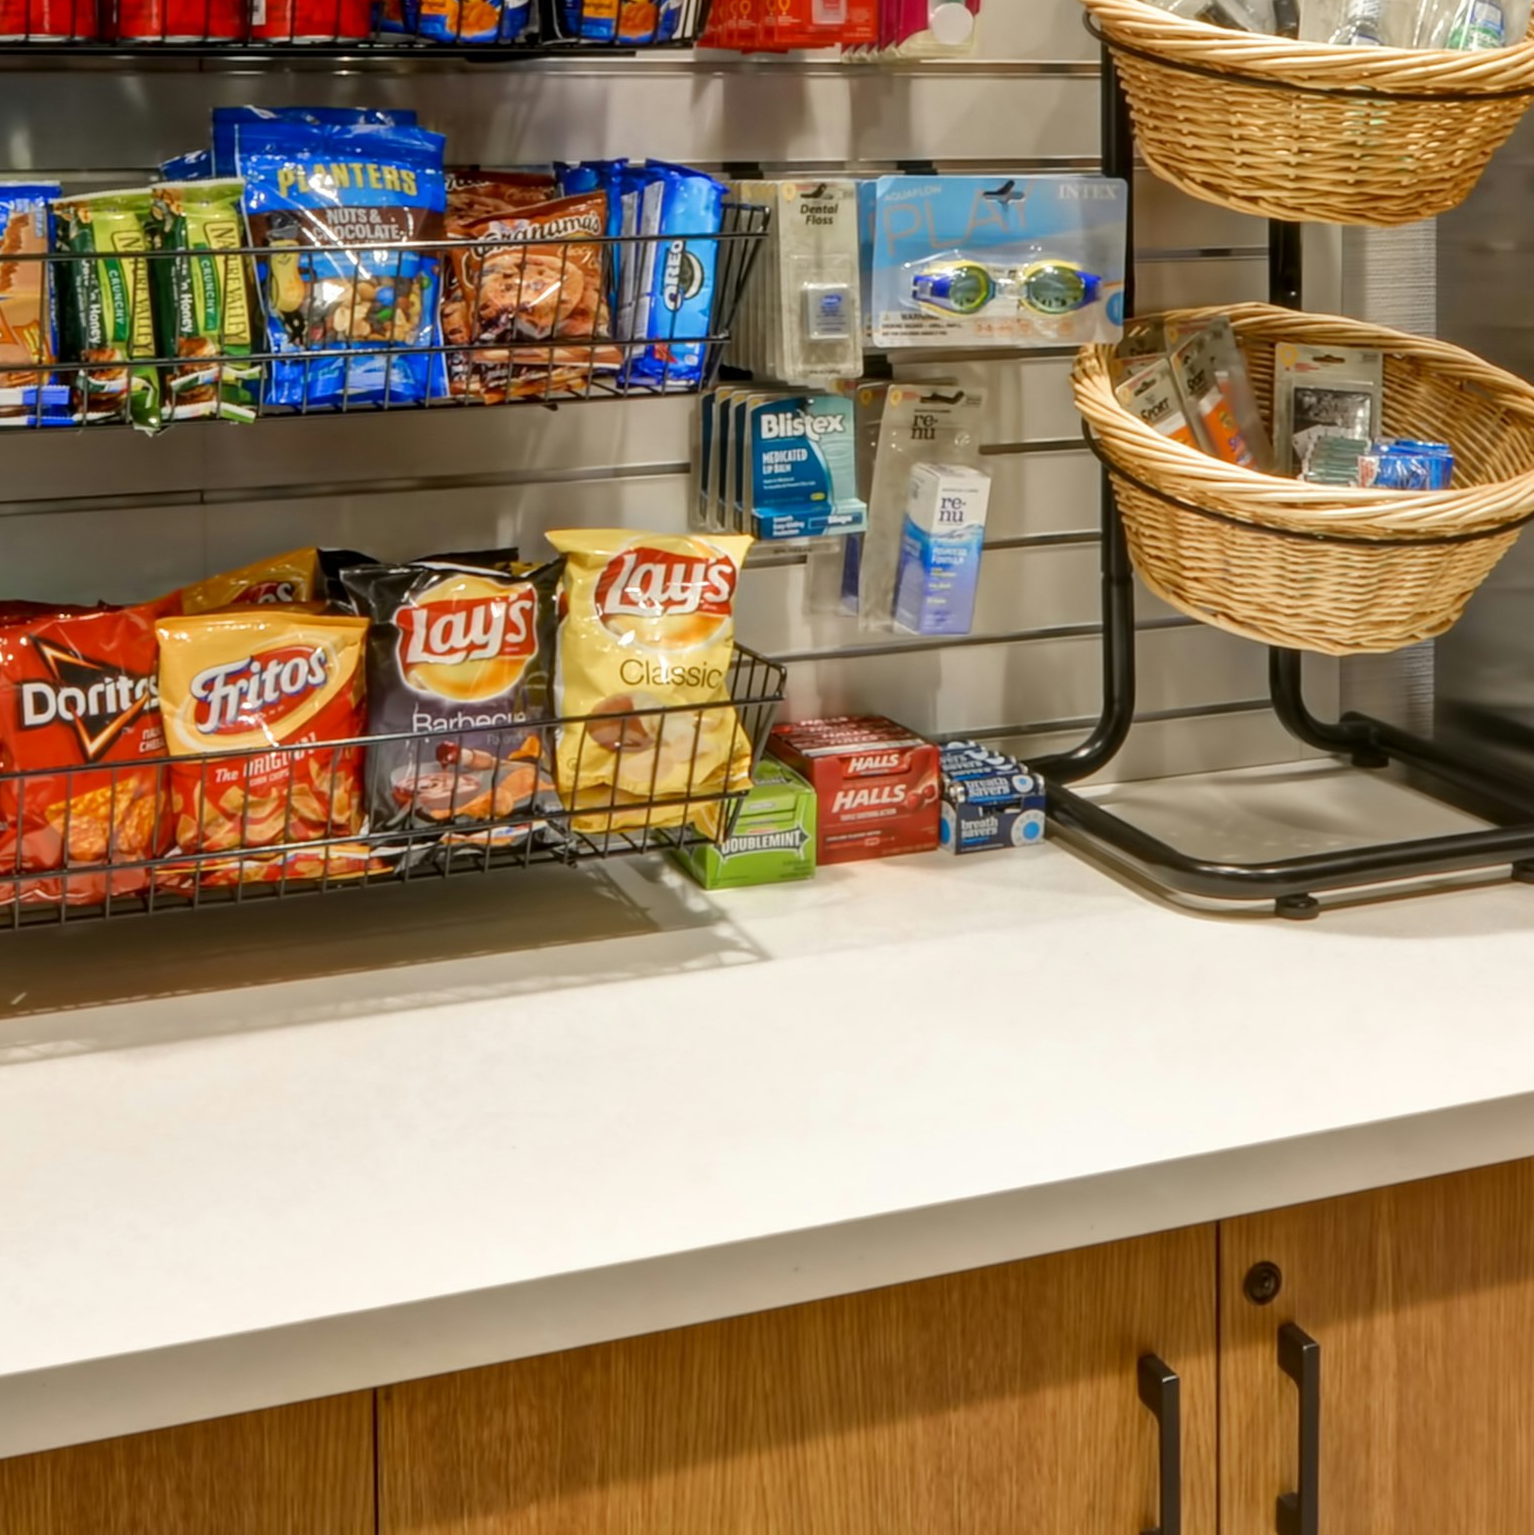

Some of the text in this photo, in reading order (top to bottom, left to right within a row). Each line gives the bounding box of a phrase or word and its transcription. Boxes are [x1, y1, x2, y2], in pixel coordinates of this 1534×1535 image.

[277, 162, 419, 198] PLANTERS
[1058, 182, 1118, 201] INTEX
[325, 207, 383, 224] NUTS &
[800, 202, 839, 217] Dental
[805, 214, 834, 227] Floss
[312, 223, 401, 241] CHOCOLATE
[200, 259, 217, 315] CRUNCHY
[663, 240, 687, 312] OREO
[108, 269, 126, 325] CRUNCHY
[88, 303, 102, 345] Honey
[180, 293, 194, 334] Honey
[760, 411, 845, 442] Blistex
[762, 448, 808, 464] MEDICATED
[604, 552, 733, 618] Lay's
[406, 593, 534, 665] Lay's
[619, 658, 723, 689] Classic
[22, 674, 159, 727] Doritos
[190, 647, 328, 735] Fritos
[215, 768, 239, 783] The
[847, 753, 900, 774] HALLS
[831, 784, 907, 814] HALLS
[960, 815, 1000, 829] breath
[960, 826, 999, 840] savers
[721, 829, 802, 855] DOUBLEMINT
